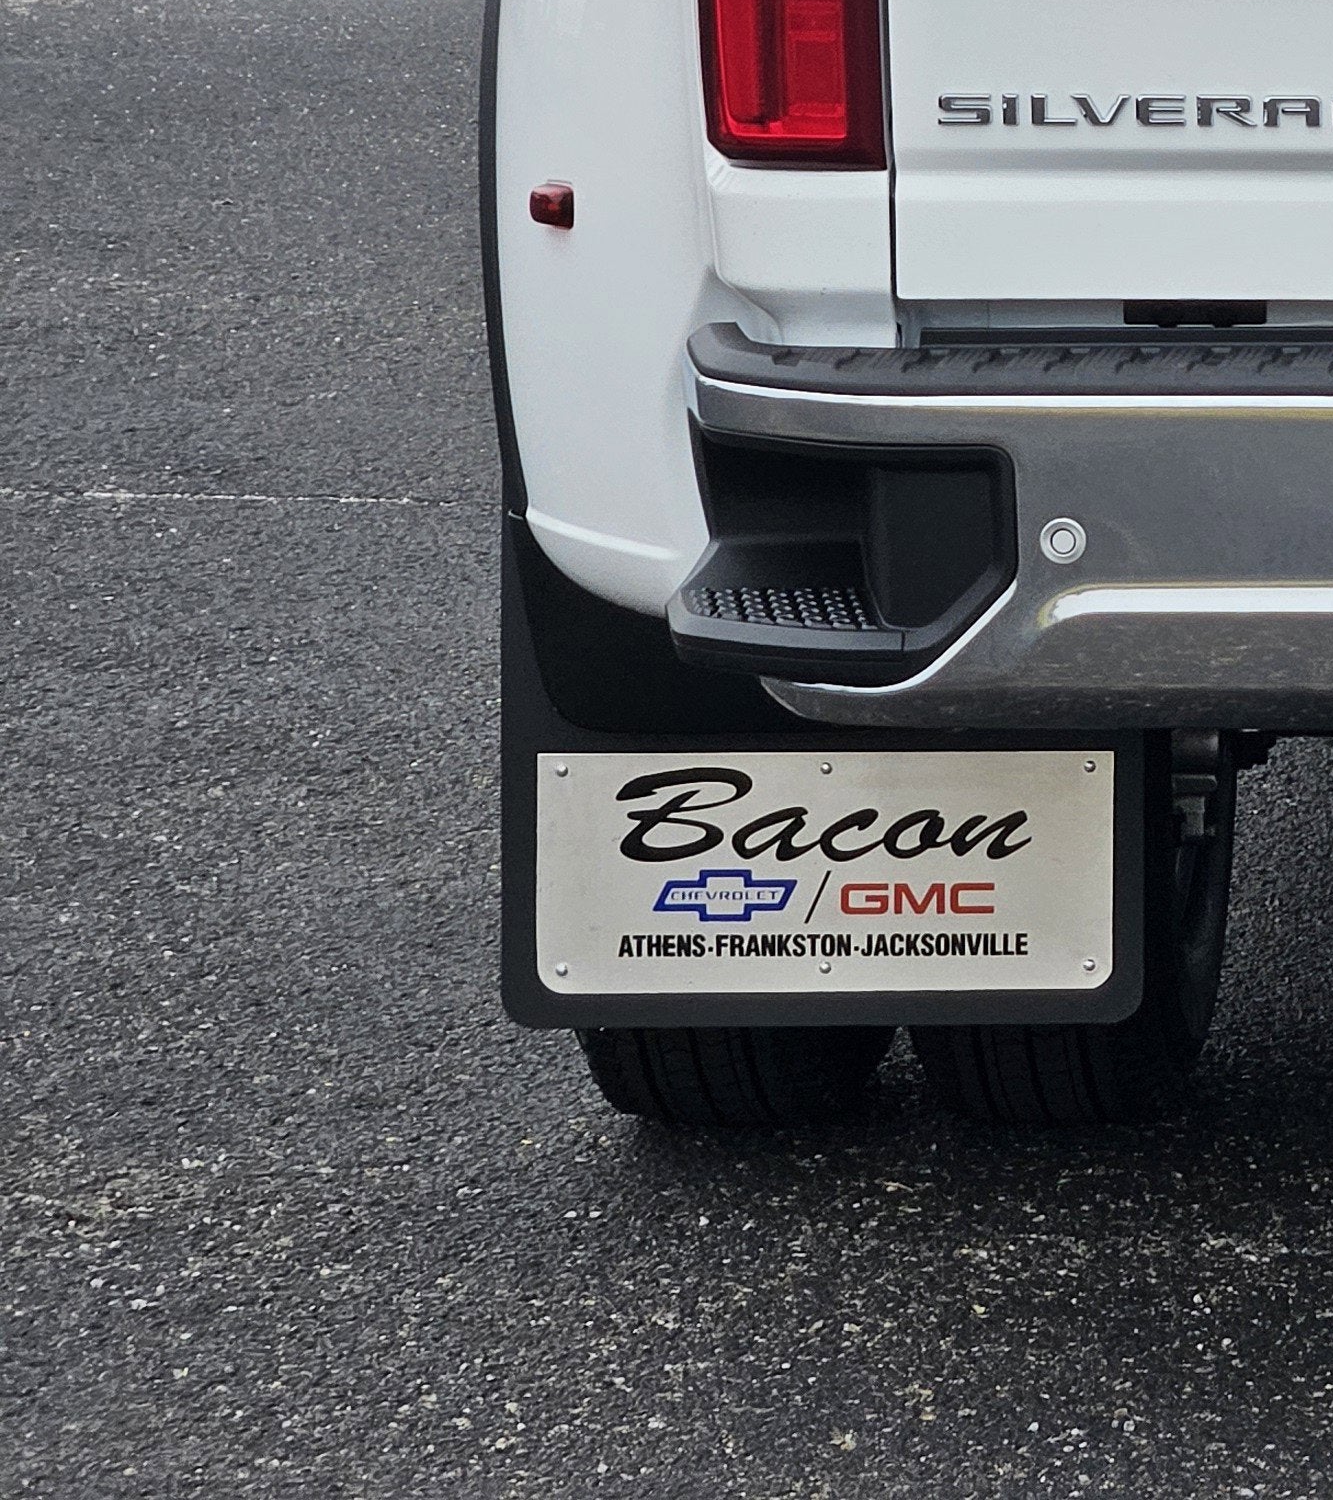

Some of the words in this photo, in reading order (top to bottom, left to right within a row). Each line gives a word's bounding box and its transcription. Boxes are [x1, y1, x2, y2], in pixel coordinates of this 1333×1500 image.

[615, 767, 1033, 862] Bacon
[670, 890, 780, 901] CHEVROLET
[840, 882, 995, 915] GMC
